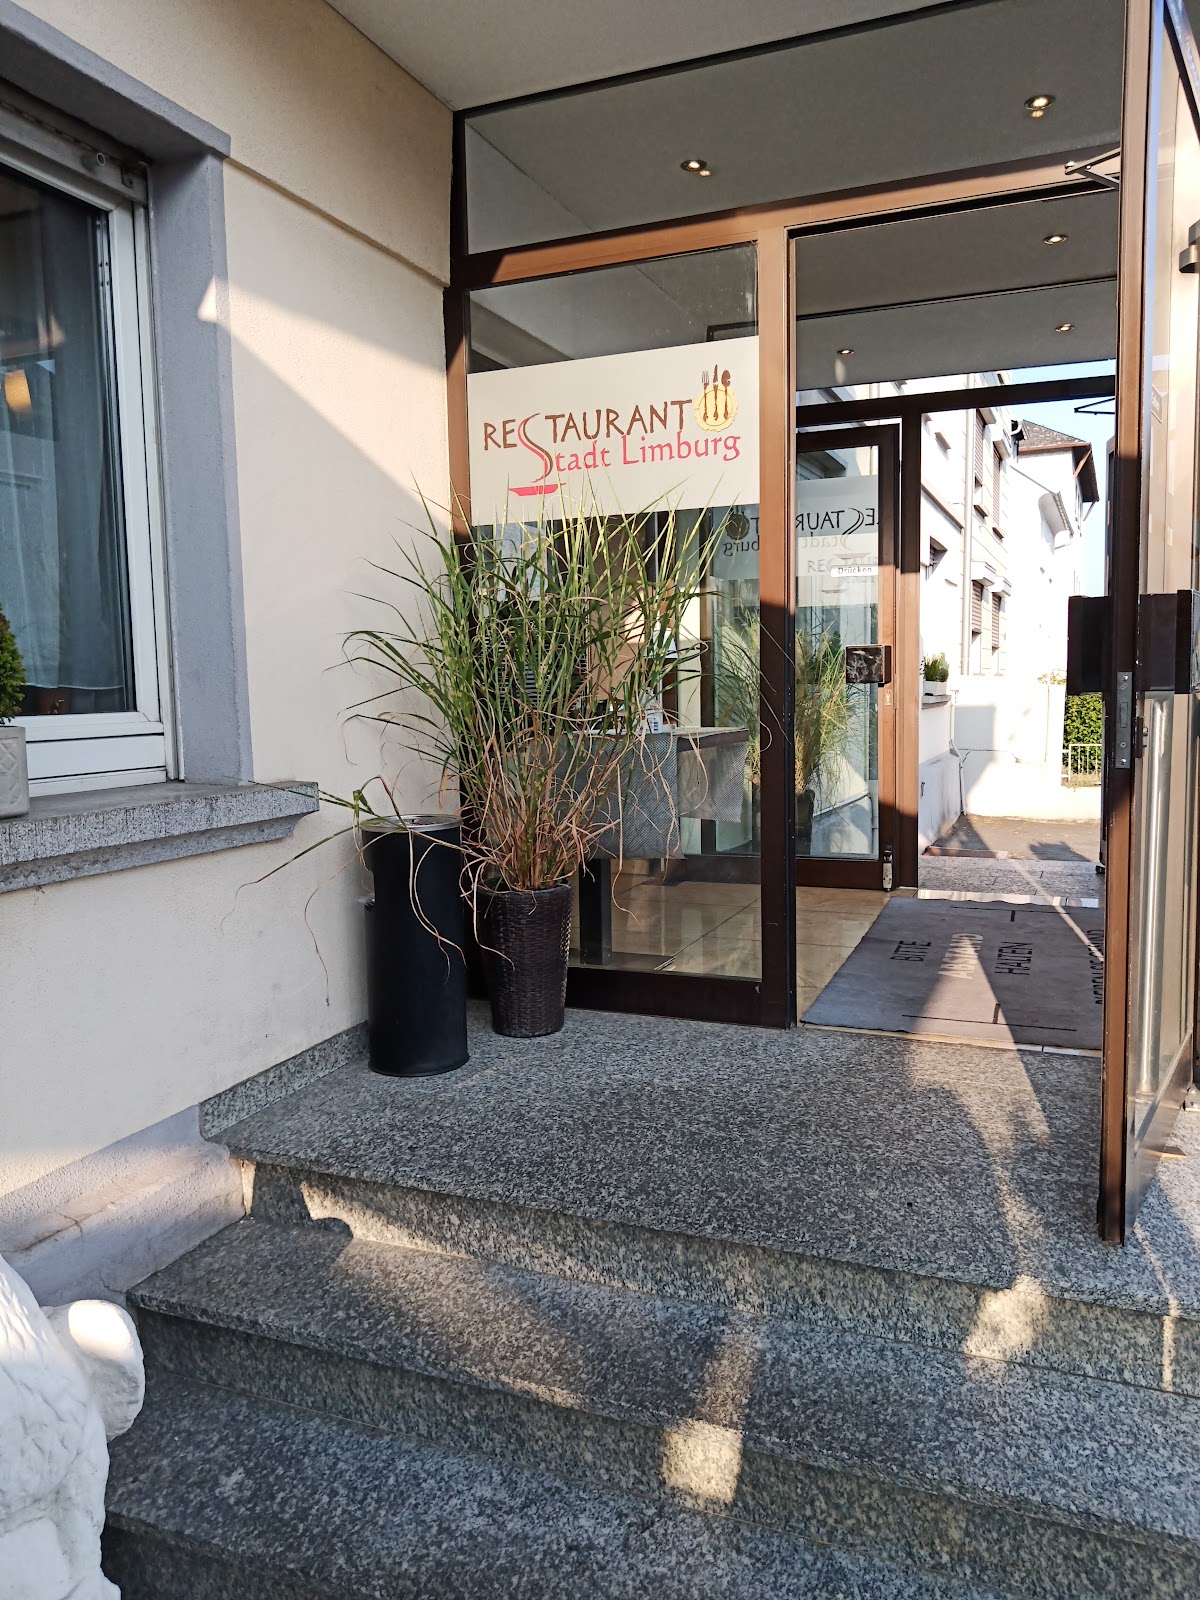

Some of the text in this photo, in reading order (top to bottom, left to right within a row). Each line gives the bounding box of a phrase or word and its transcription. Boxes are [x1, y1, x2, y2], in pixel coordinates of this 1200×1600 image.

[484, 399, 692, 483] RESTAURANT
[518, 412, 741, 484] Stadt Limburg
[837, 565, 873, 575] Drücken
[890, 940, 932, 962] BITTE
[938, 933, 984, 980] ABSTAND
[994, 941, 1033, 976] HALTEN
